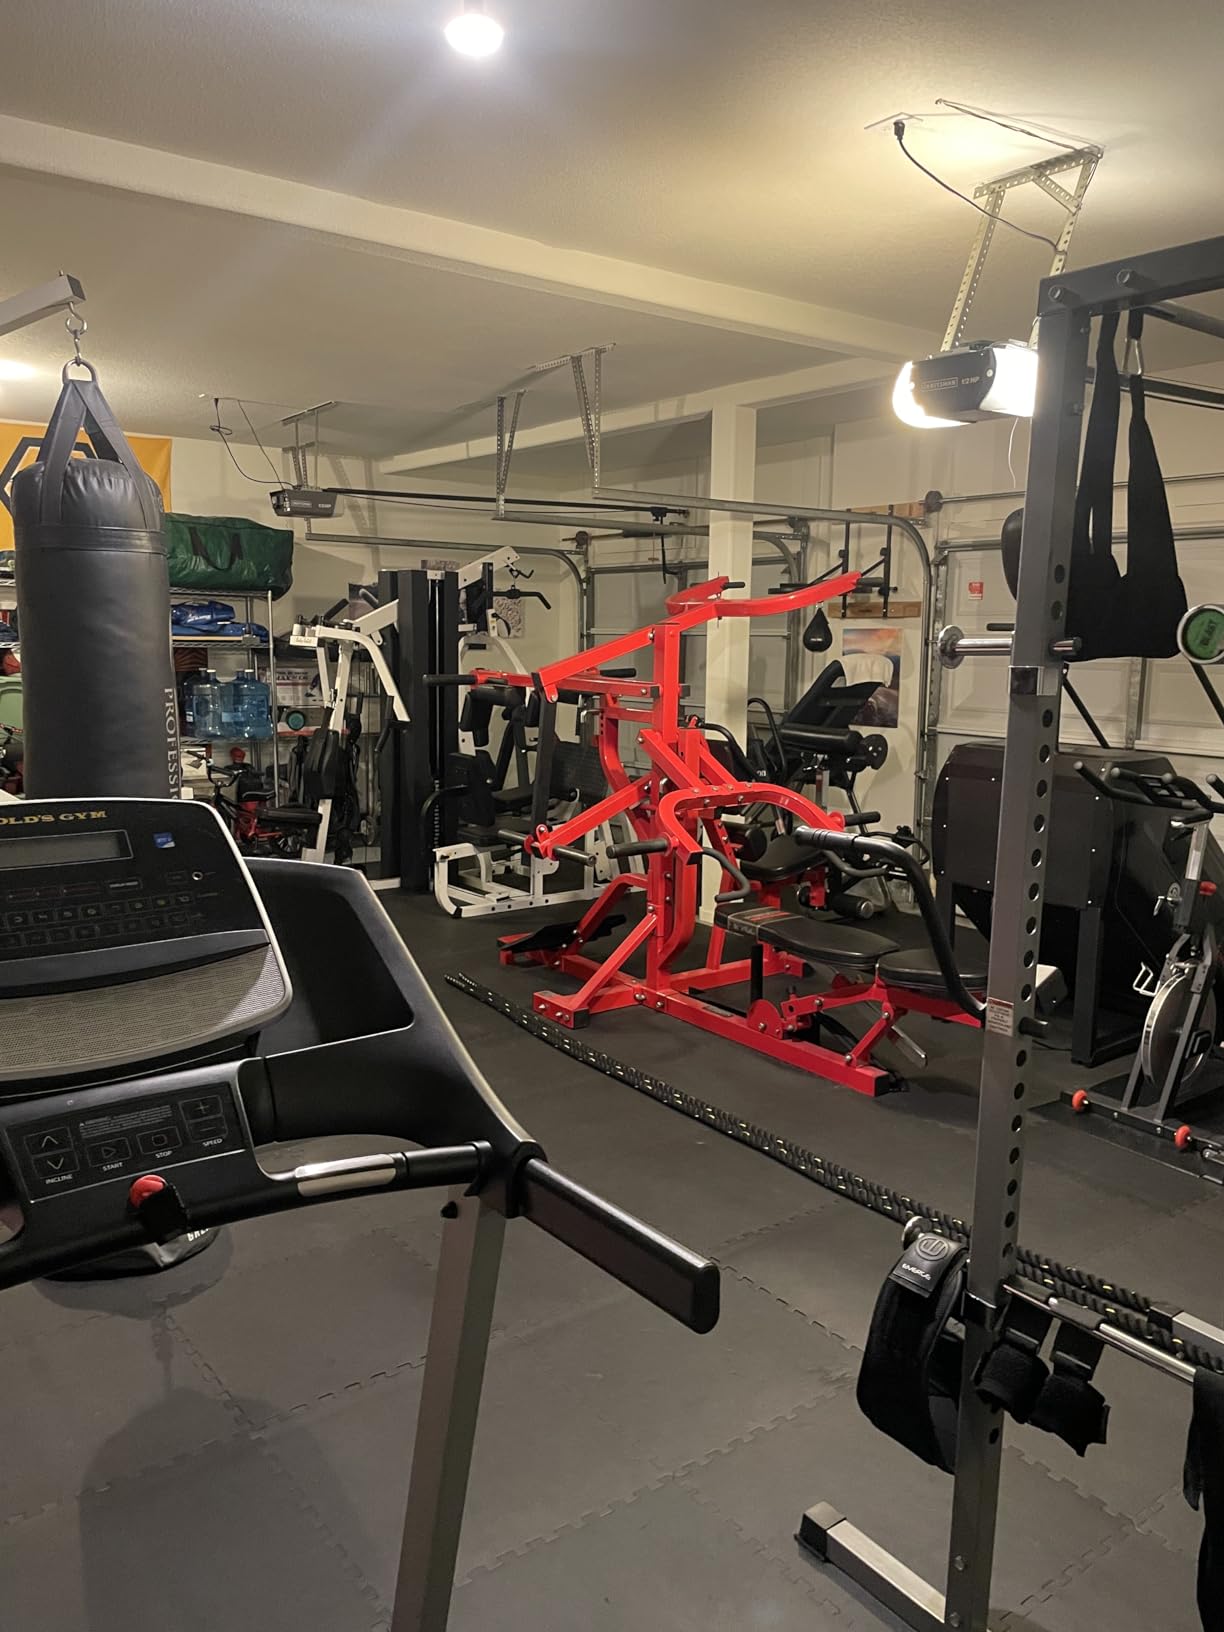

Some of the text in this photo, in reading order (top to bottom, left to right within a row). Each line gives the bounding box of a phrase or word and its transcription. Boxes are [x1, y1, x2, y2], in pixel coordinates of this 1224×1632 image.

[59, 811, 107, 820] GYM
[202, 1138, 223, 1147] SPEED
[155, 1150, 172, 1158] STOP
[102, 1162, 123, 1171] START
[46, 1174, 73, 1184] INCLINE
